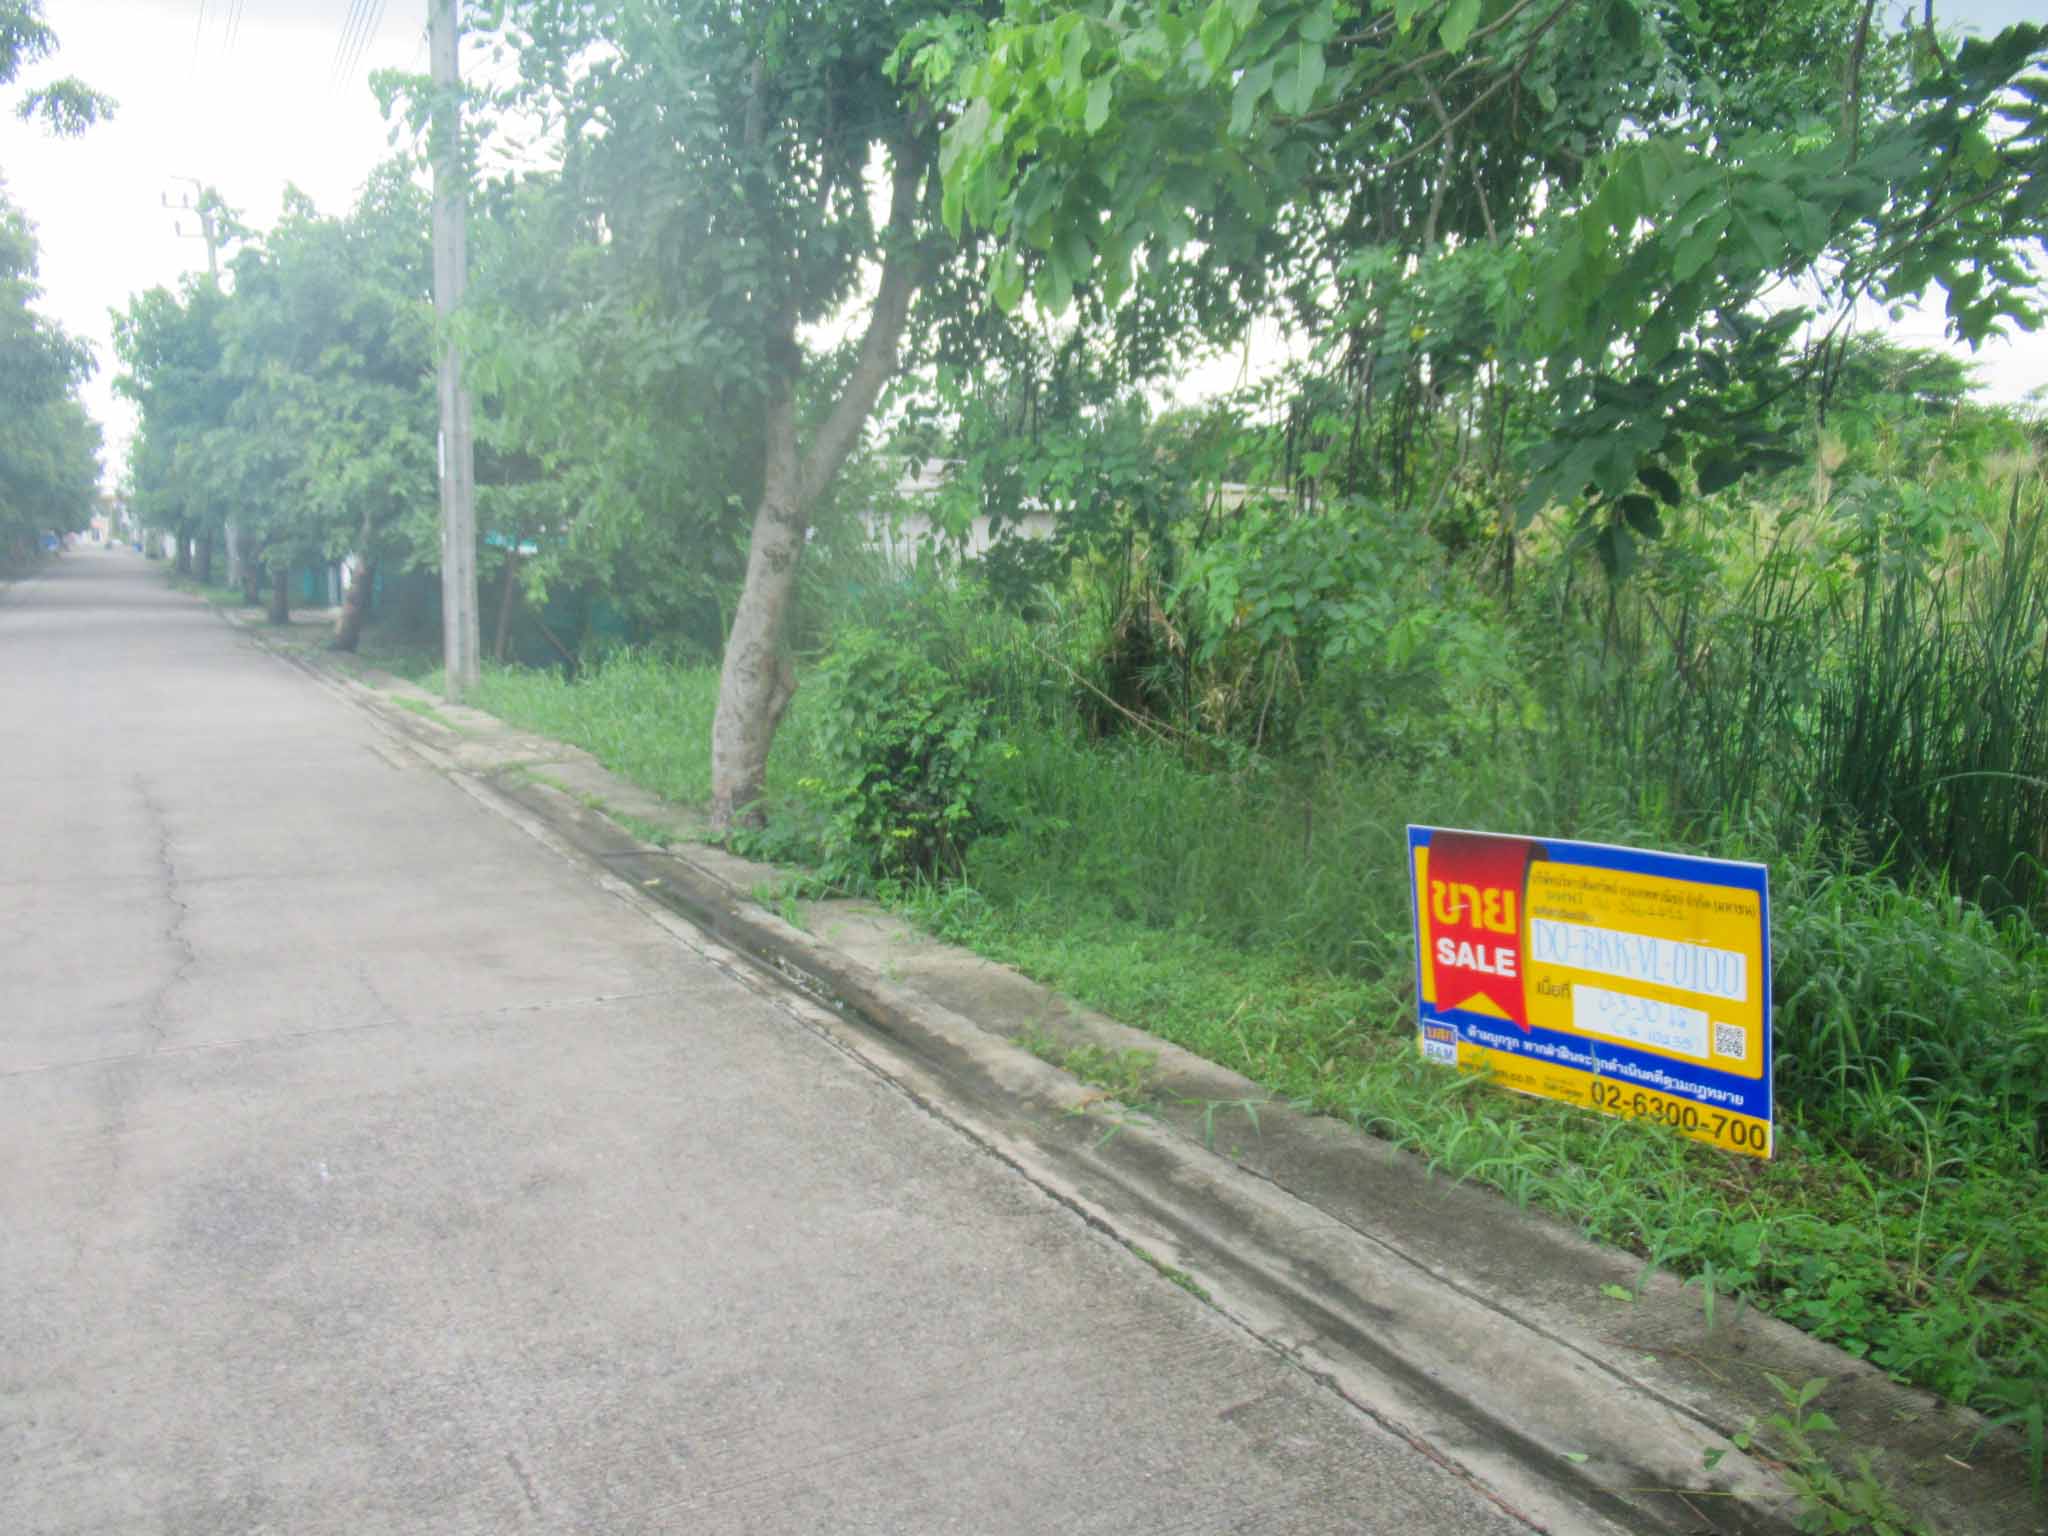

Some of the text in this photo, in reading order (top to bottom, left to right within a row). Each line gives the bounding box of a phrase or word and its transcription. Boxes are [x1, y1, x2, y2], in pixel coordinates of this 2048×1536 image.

[1431, 879, 1516, 935] ขาย
[1437, 937, 1517, 978] SALE
[1590, 1080, 1766, 1151] 02-6300-700
